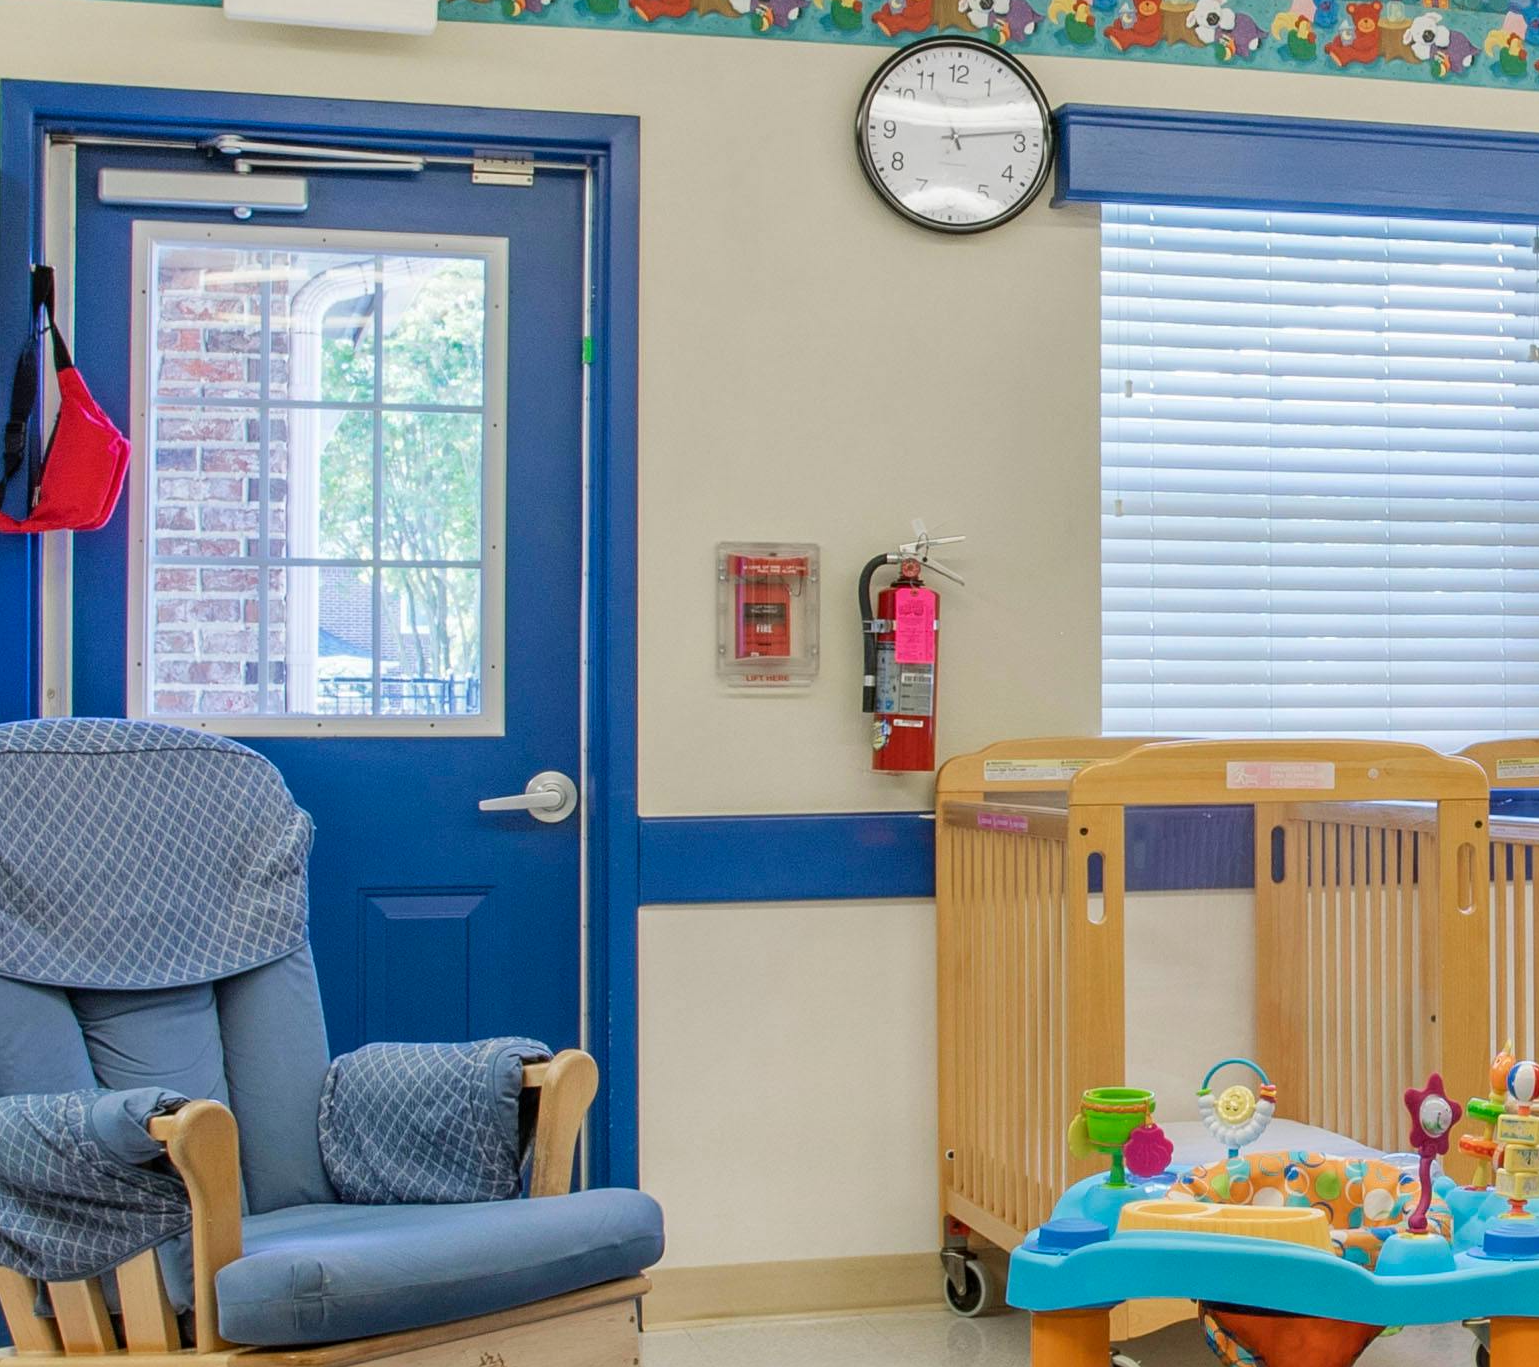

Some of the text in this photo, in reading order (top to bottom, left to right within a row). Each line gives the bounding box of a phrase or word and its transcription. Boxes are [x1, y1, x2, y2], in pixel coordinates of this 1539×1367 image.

[917, 70, 936, 91] 11
[948, 64, 970, 85] 12
[984, 78, 992, 97] 1
[883, 120, 897, 139] 9
[1013, 134, 1026, 153] 3
[891, 151, 904, 171] 8
[1001, 164, 1014, 183] 4
[756, 623, 772, 633] FIRE
[766, 674, 790, 682] HERE
